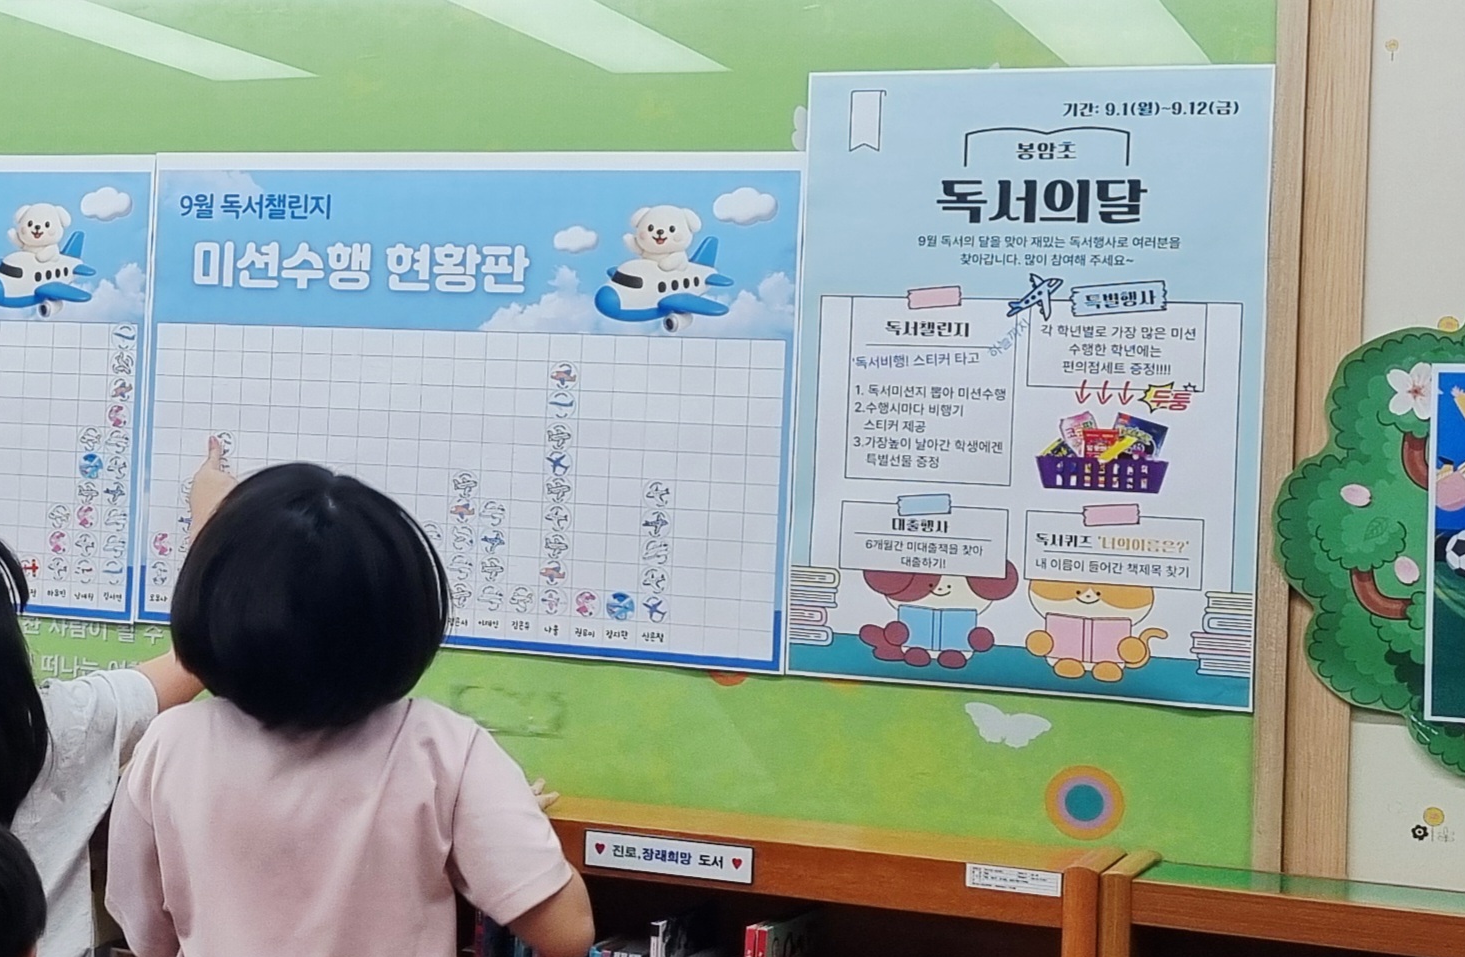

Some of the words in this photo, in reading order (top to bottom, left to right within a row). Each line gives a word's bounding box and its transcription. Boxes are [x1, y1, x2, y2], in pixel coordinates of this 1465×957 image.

[1063, 102, 1100, 117] 기간:
[1104, 100, 1240, 117] 9.1(월)~9.12(금)
[1016, 141, 1077, 161] 봉암초
[179, 195, 215, 219] 9월
[220, 194, 332, 220] 독서챌린지
[936, 179, 1148, 224] 독서의달
[917, 235, 937, 247] 9월
[941, 235, 975, 248] 독서의
[978, 235, 1001, 248] 달을
[1004, 235, 1027, 248] 맞아
[1031, 236, 1066, 249] 재밌는
[1069, 236, 1128, 249] 독서행사로
[1132, 237, 1180, 250] 여러분을
[193, 240, 371, 290] 미션수행
[387, 243, 529, 294] 현황판
[960, 254, 1021, 267] 찾아갑니다.
[1025, 254, 1047, 267] 많이
[1051, 254, 1086, 267] 참여해
[1089, 254, 1134, 267] 주세요~
[1085, 290, 1156, 308] 특별행사
[885, 320, 970, 338] 독서챌린지
[1040, 324, 1053, 338] 각
[1057, 324, 1107, 338] 학년별로
[1111, 325, 1137, 339] 가장
[1141, 326, 1166, 340] 많은
[1171, 326, 1196, 340] 미션
[1068, 343, 1106, 357] 수행한
[1110, 343, 1161, 358] 학년에는
[913, 353, 950, 367] 스티커
[954, 352, 980, 366] 타고
[1062, 360, 1125, 375] 편의점세트
[1130, 361, 1171, 376] 증정!!!!
[855, 385, 864, 396] 1.
[868, 385, 926, 398] 독서미션지
[930, 386, 954, 399] 뽑아
[957, 387, 1007, 401] 미션수행
[1148, 390, 1191, 411] 두둥
[855, 402, 925, 416] 2.수행시마다
[929, 403, 964, 417] 비행기
[863, 418, 899, 432] 스티커
[902, 419, 926, 433] 제공
[853, 436, 911, 451] 3.가장높이
[915, 438, 950, 452] 날아간
[954, 439, 1003, 454] 학생에겐
[866, 453, 914, 468] 특별선물
[918, 454, 940, 469] 증정
[892, 517, 948, 534] 대출행사
[865, 538, 903, 553] 6개월간
[906, 540, 958, 555] 미대출책을
[961, 543, 983, 557] 찾아
[1036, 533, 1092, 550] 독서퀴즈
[901, 555, 946, 569] 대출하기!
[1036, 558, 1047, 572] 내
[1050, 559, 1085, 573] 이름이
[1088, 560, 1123, 575] 들어간
[1127, 562, 1162, 577] 책제목
[1165, 564, 1189, 579] 찾기
[143, 625, 164, 645] 수
[611, 843, 692, 866] 진로,장래희망
[698, 852, 724, 870] 도서
